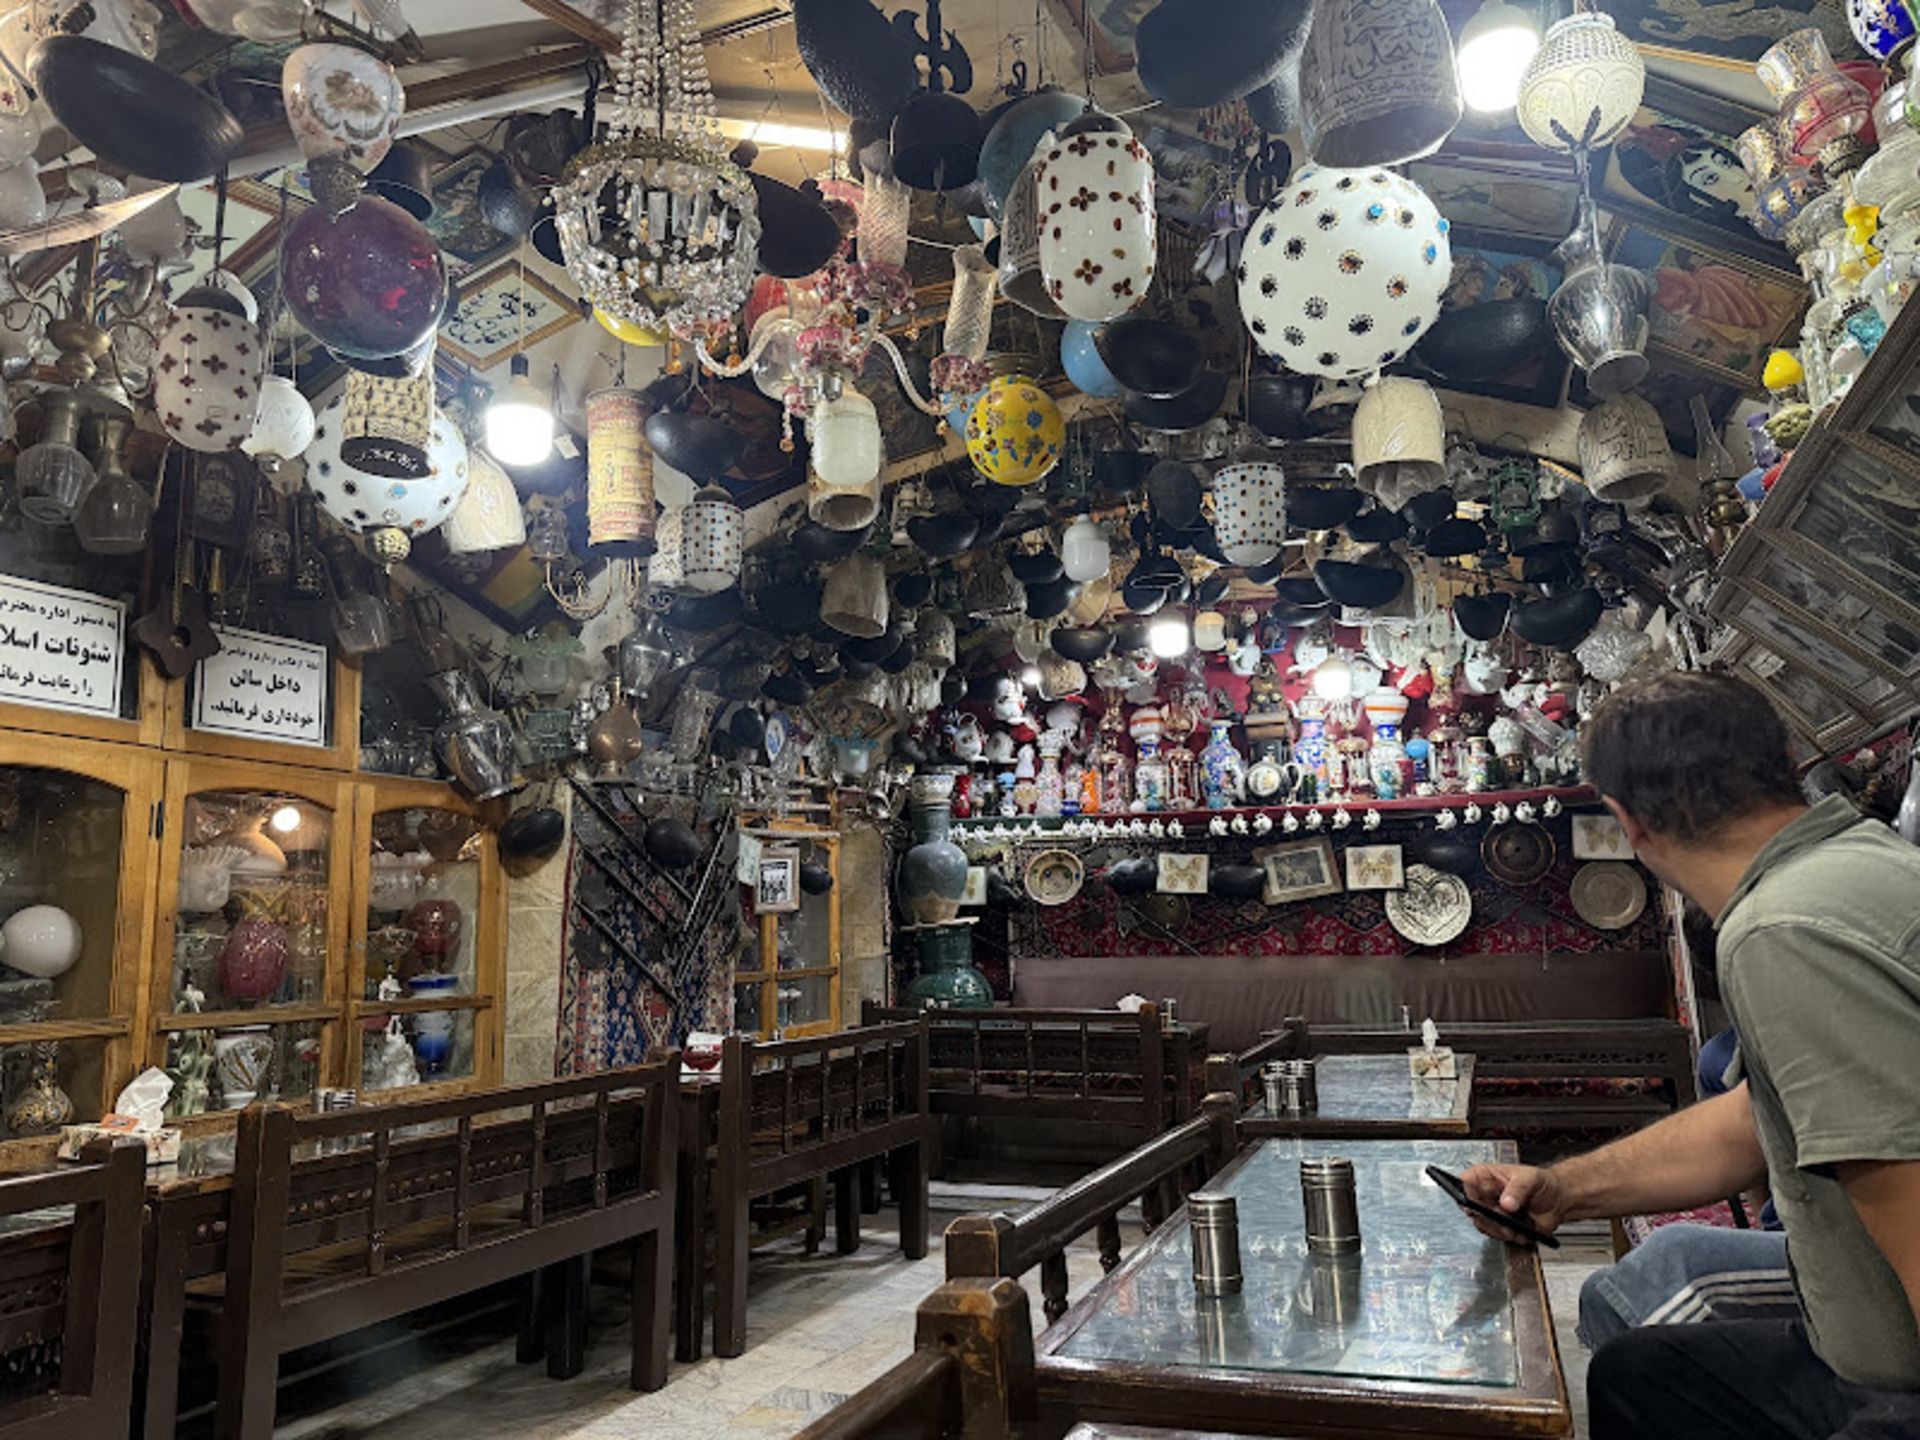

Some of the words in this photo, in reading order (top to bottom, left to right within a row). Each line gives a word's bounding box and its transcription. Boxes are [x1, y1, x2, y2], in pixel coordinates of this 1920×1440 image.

[40, 605, 71, 620] اداره
[44, 634, 111, 666] شئونات
[37, 674, 80, 695] رعایت
[82, 678, 93, 697] را
[230, 668, 262, 688] سالن
[266, 673, 301, 693] داخل
[261, 708, 314, 728] خودداری
